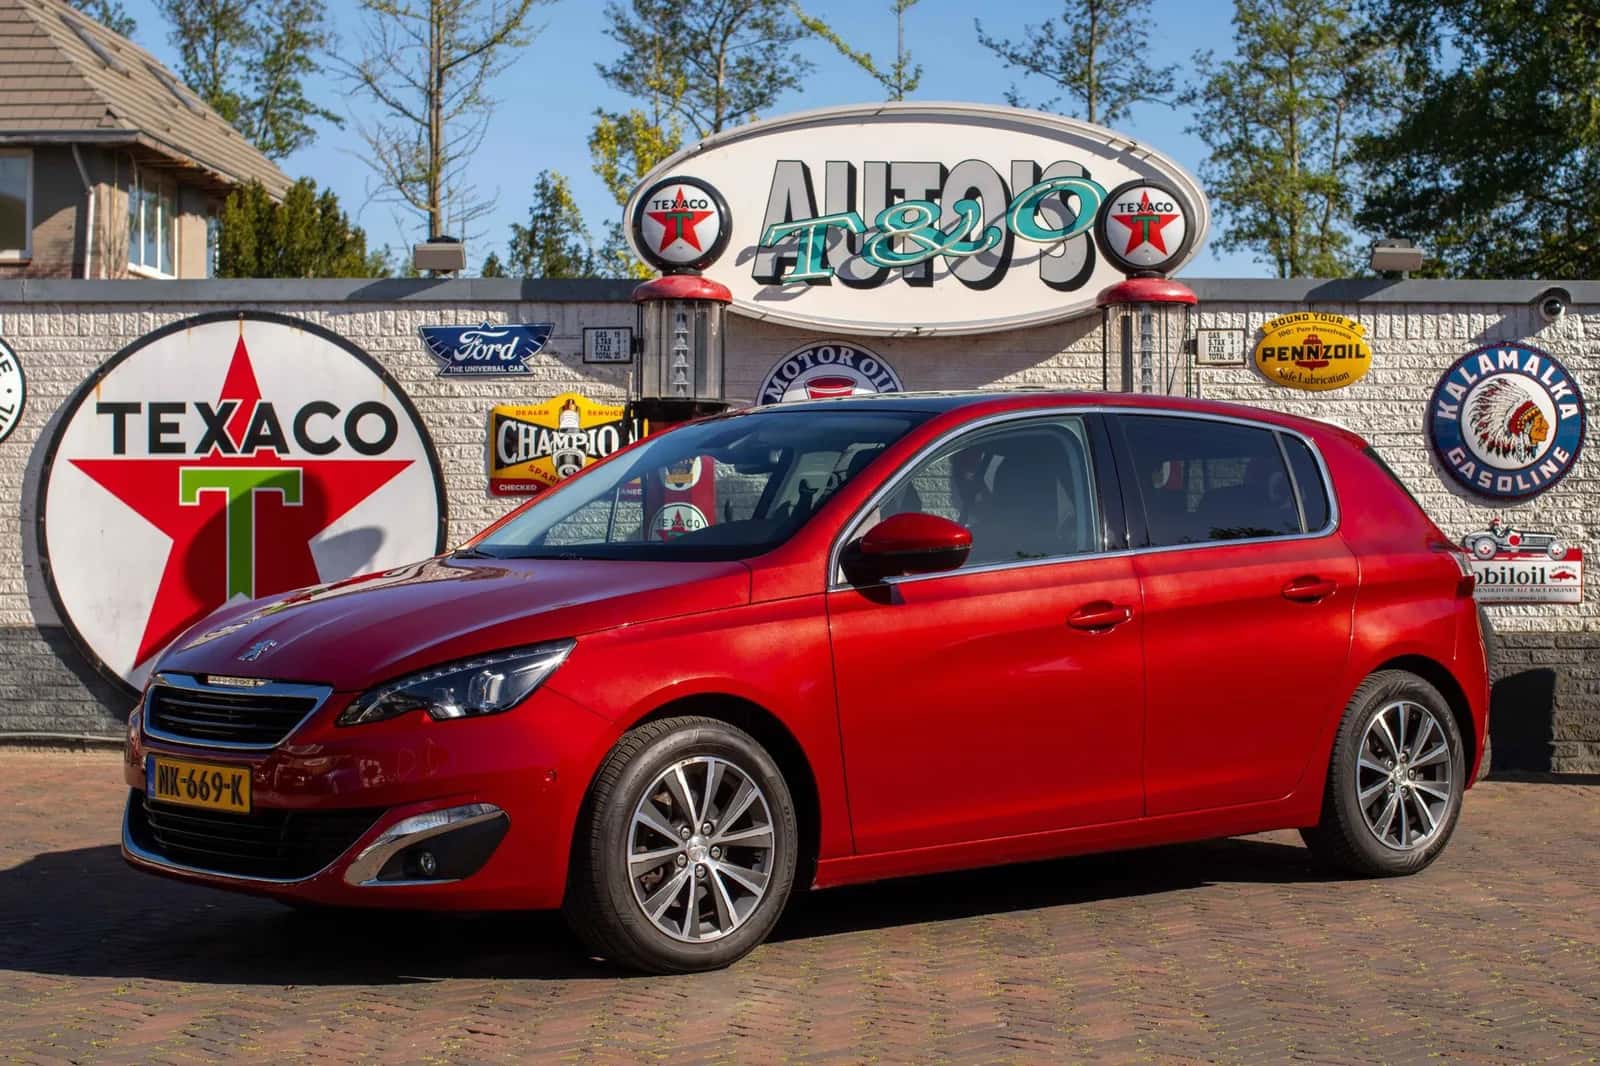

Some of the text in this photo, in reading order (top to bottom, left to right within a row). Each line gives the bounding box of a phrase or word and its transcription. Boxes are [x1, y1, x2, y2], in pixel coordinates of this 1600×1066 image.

[653, 199, 709, 210] TEXACO
[1117, 202, 1174, 213] TEXACO
[751, 158, 1097, 292] AUTO'S
[1271, 314, 1309, 329] SOUND
[1313, 312, 1344, 324] YOUR
[454, 330, 520, 361] Ford
[1208, 353, 1226, 361] TOTAL
[1261, 344, 1366, 362] PENNZOIL
[464, 365, 506, 373] UNIVERSAL
[507, 365, 524, 373] CAR
[765, 346, 854, 402] MOTOR
[1299, 371, 1350, 385] Lubrication
[1437, 351, 1579, 420] KALAMALKA
[96, 401, 399, 456] TEXACO
[1447, 446, 1569, 492] GASOLINE
[159, 765, 244, 806] NK-669-K
